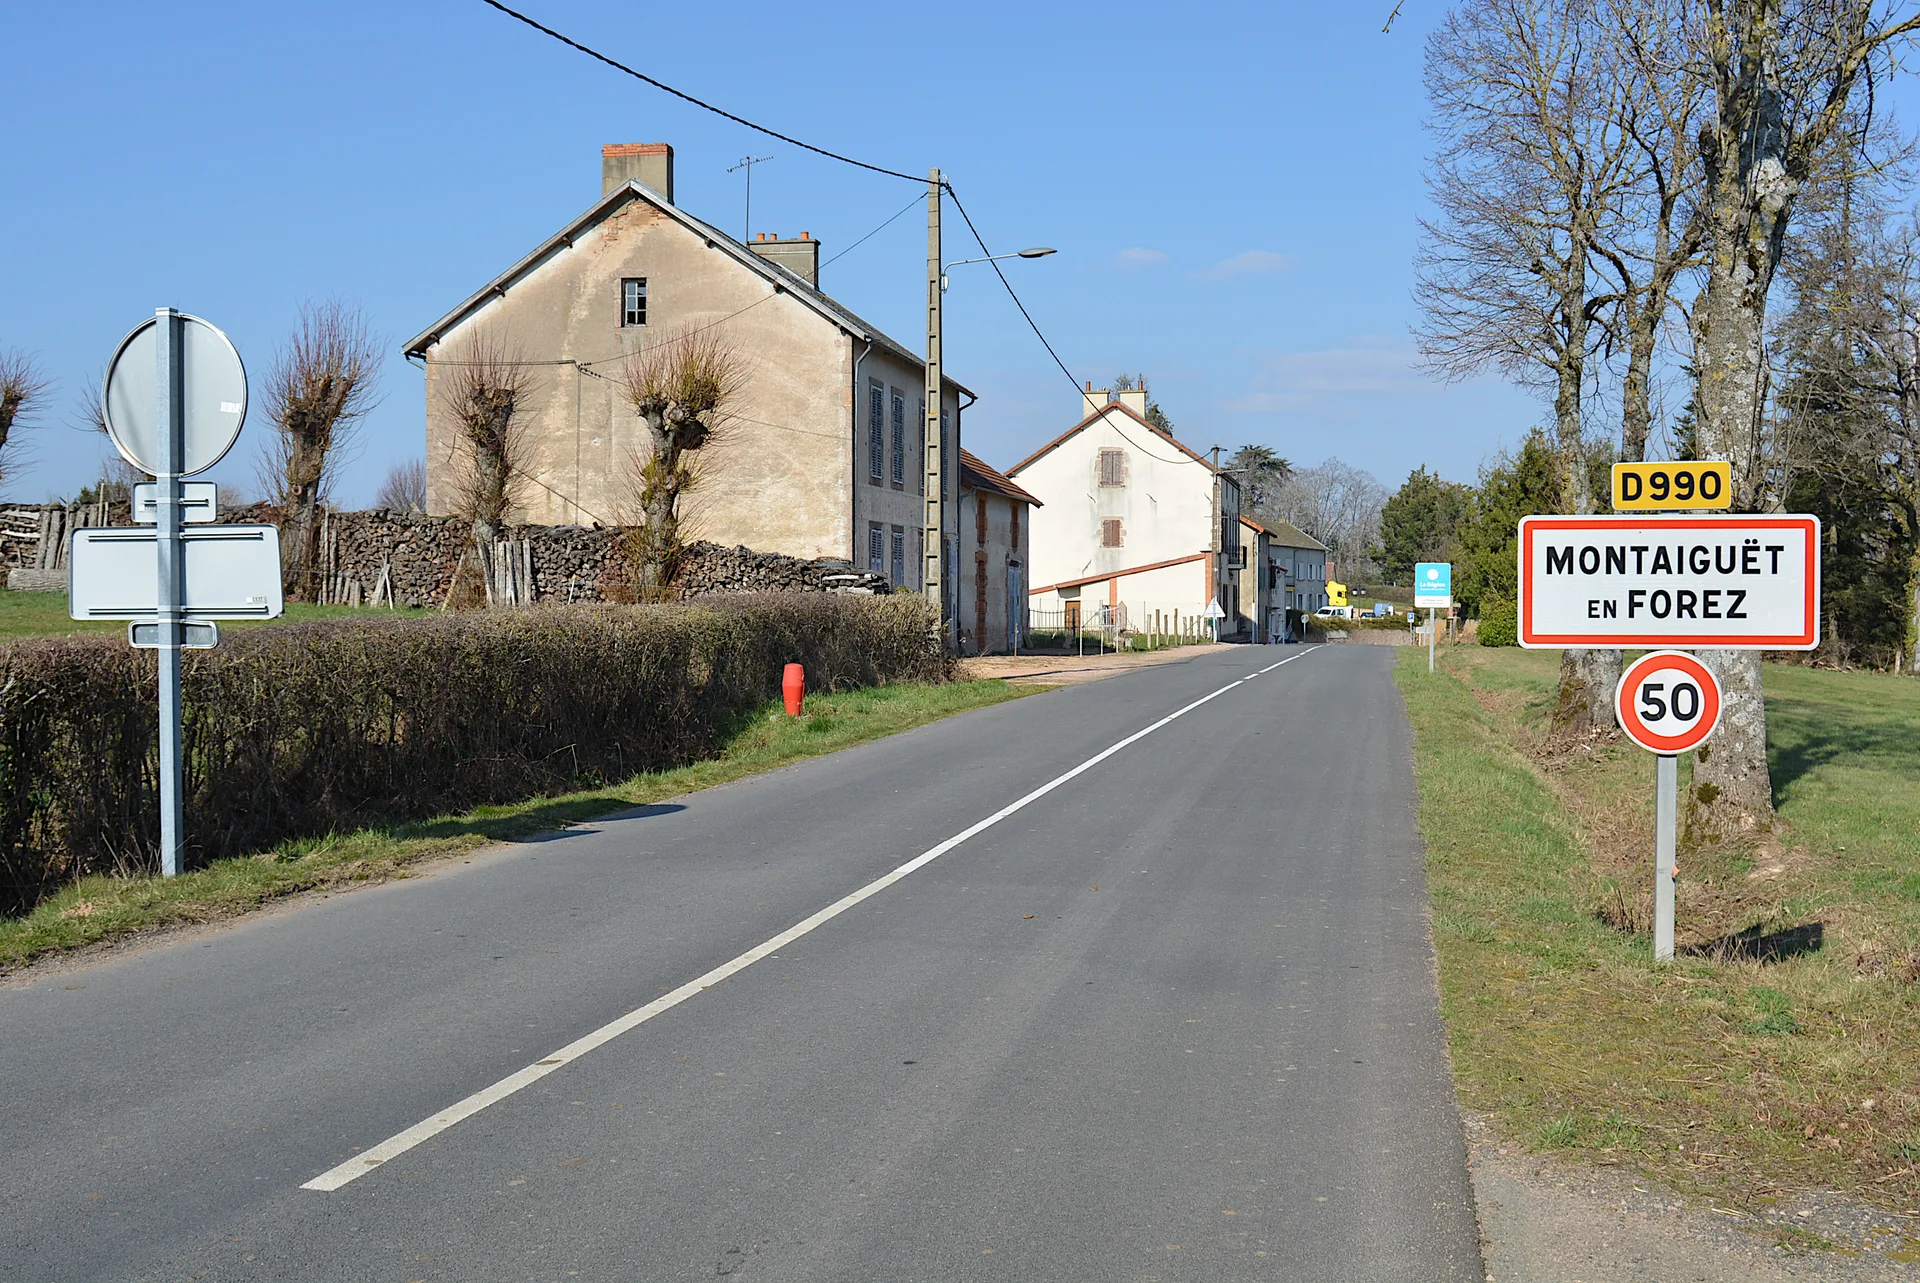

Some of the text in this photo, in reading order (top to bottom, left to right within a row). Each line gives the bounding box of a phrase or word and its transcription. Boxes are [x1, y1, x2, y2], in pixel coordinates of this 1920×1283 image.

[1622, 471, 1722, 501] D990
[1546, 538, 1784, 575] MONTAIGUËT
[1588, 589, 1747, 619] EN FOREZ
[1640, 682, 1699, 721] 50
